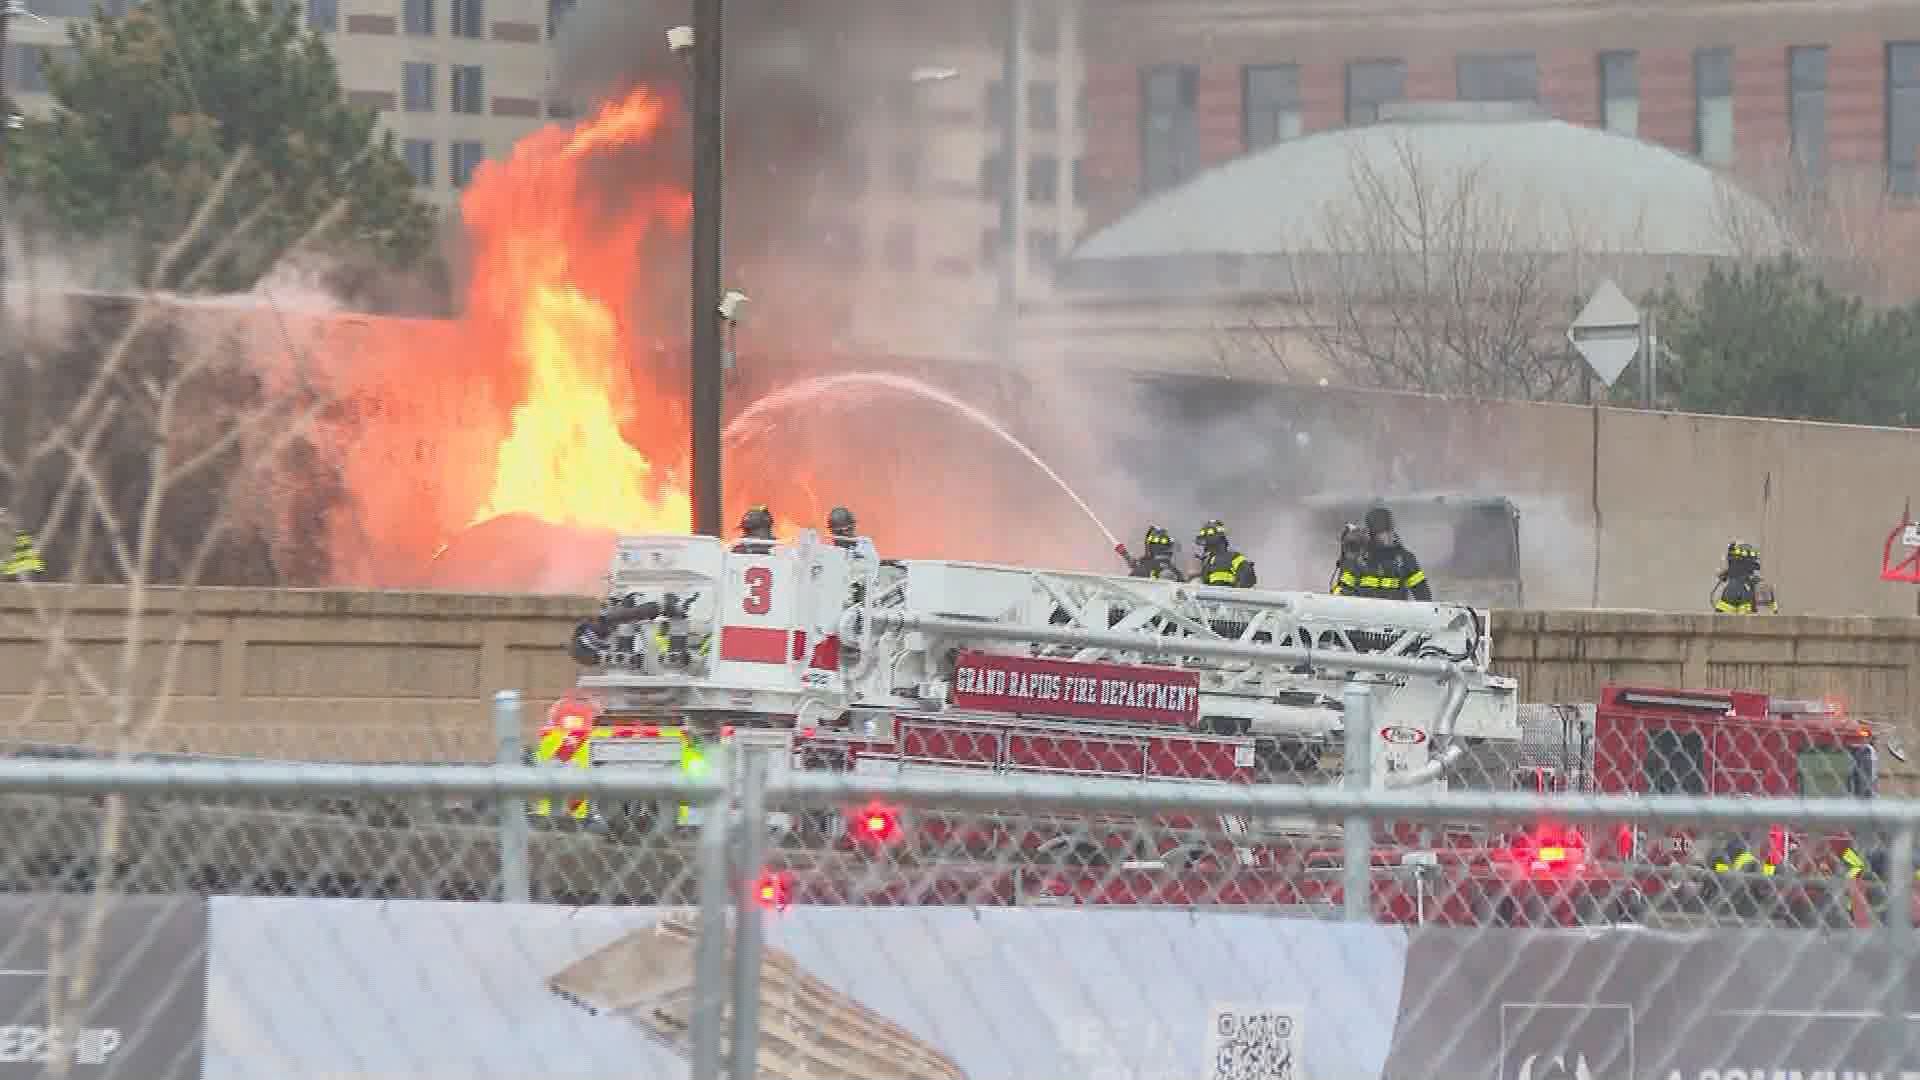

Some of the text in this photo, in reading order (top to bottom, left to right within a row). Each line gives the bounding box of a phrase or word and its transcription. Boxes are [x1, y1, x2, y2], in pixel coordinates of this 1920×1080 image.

[742, 567, 773, 615] 3
[957, 667, 1197, 712] GRAND RAPIDS FIRE DEPARTMENT
